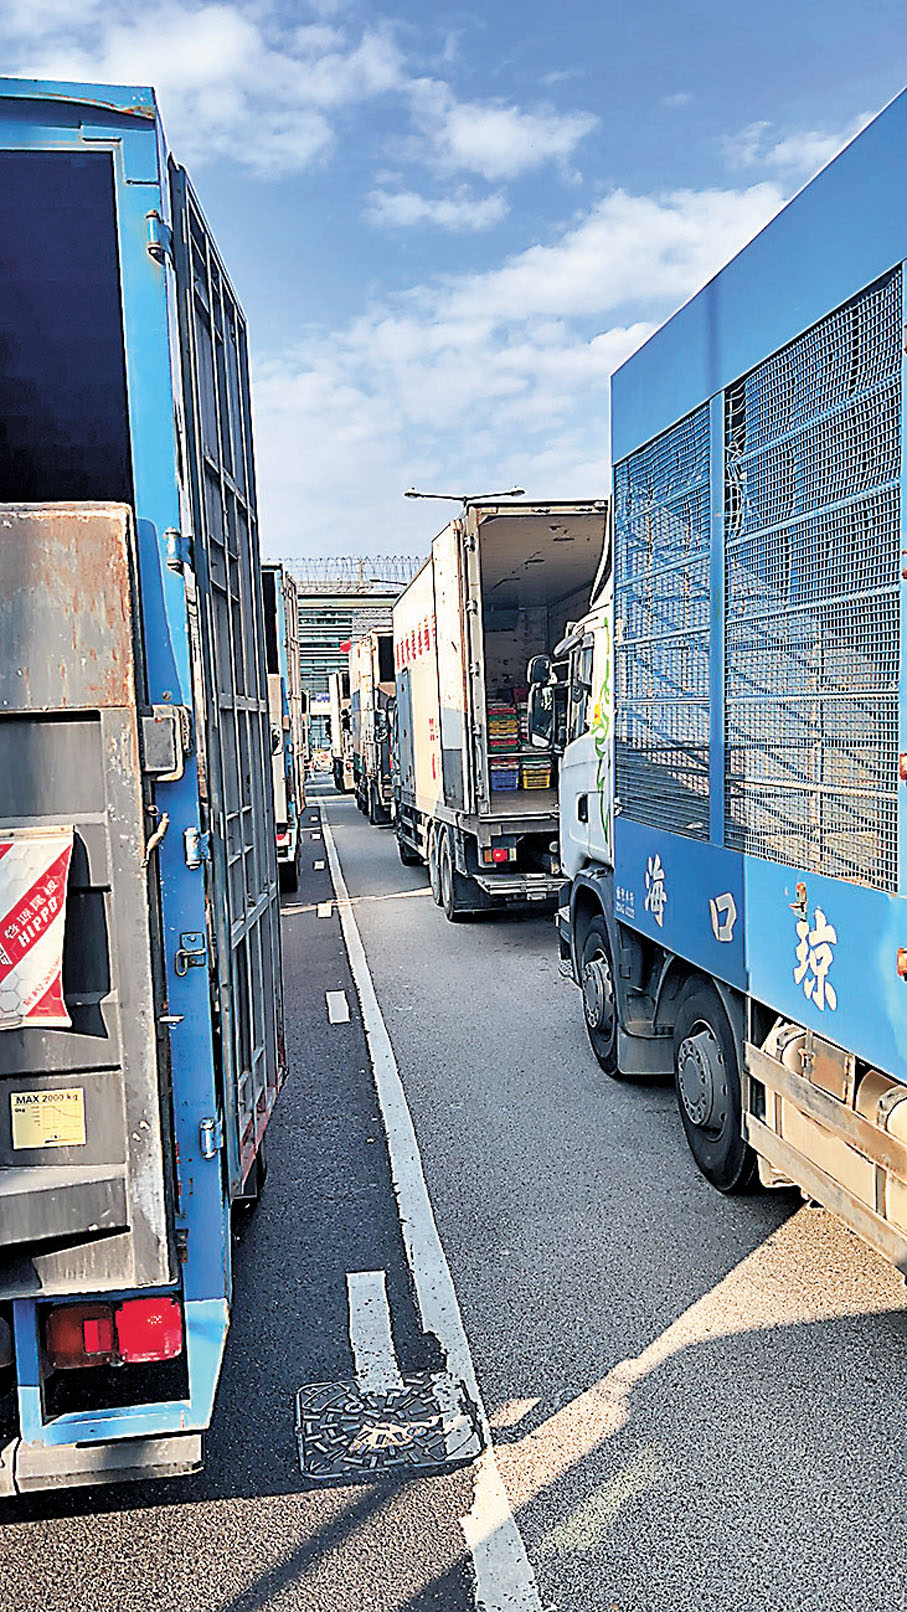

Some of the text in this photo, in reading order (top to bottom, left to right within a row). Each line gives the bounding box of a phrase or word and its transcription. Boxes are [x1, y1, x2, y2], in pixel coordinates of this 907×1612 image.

[17, 896, 59, 949] HIPPO
[16, 1095, 40, 1104] MAX
[42, 1094, 64, 1103] 2000
